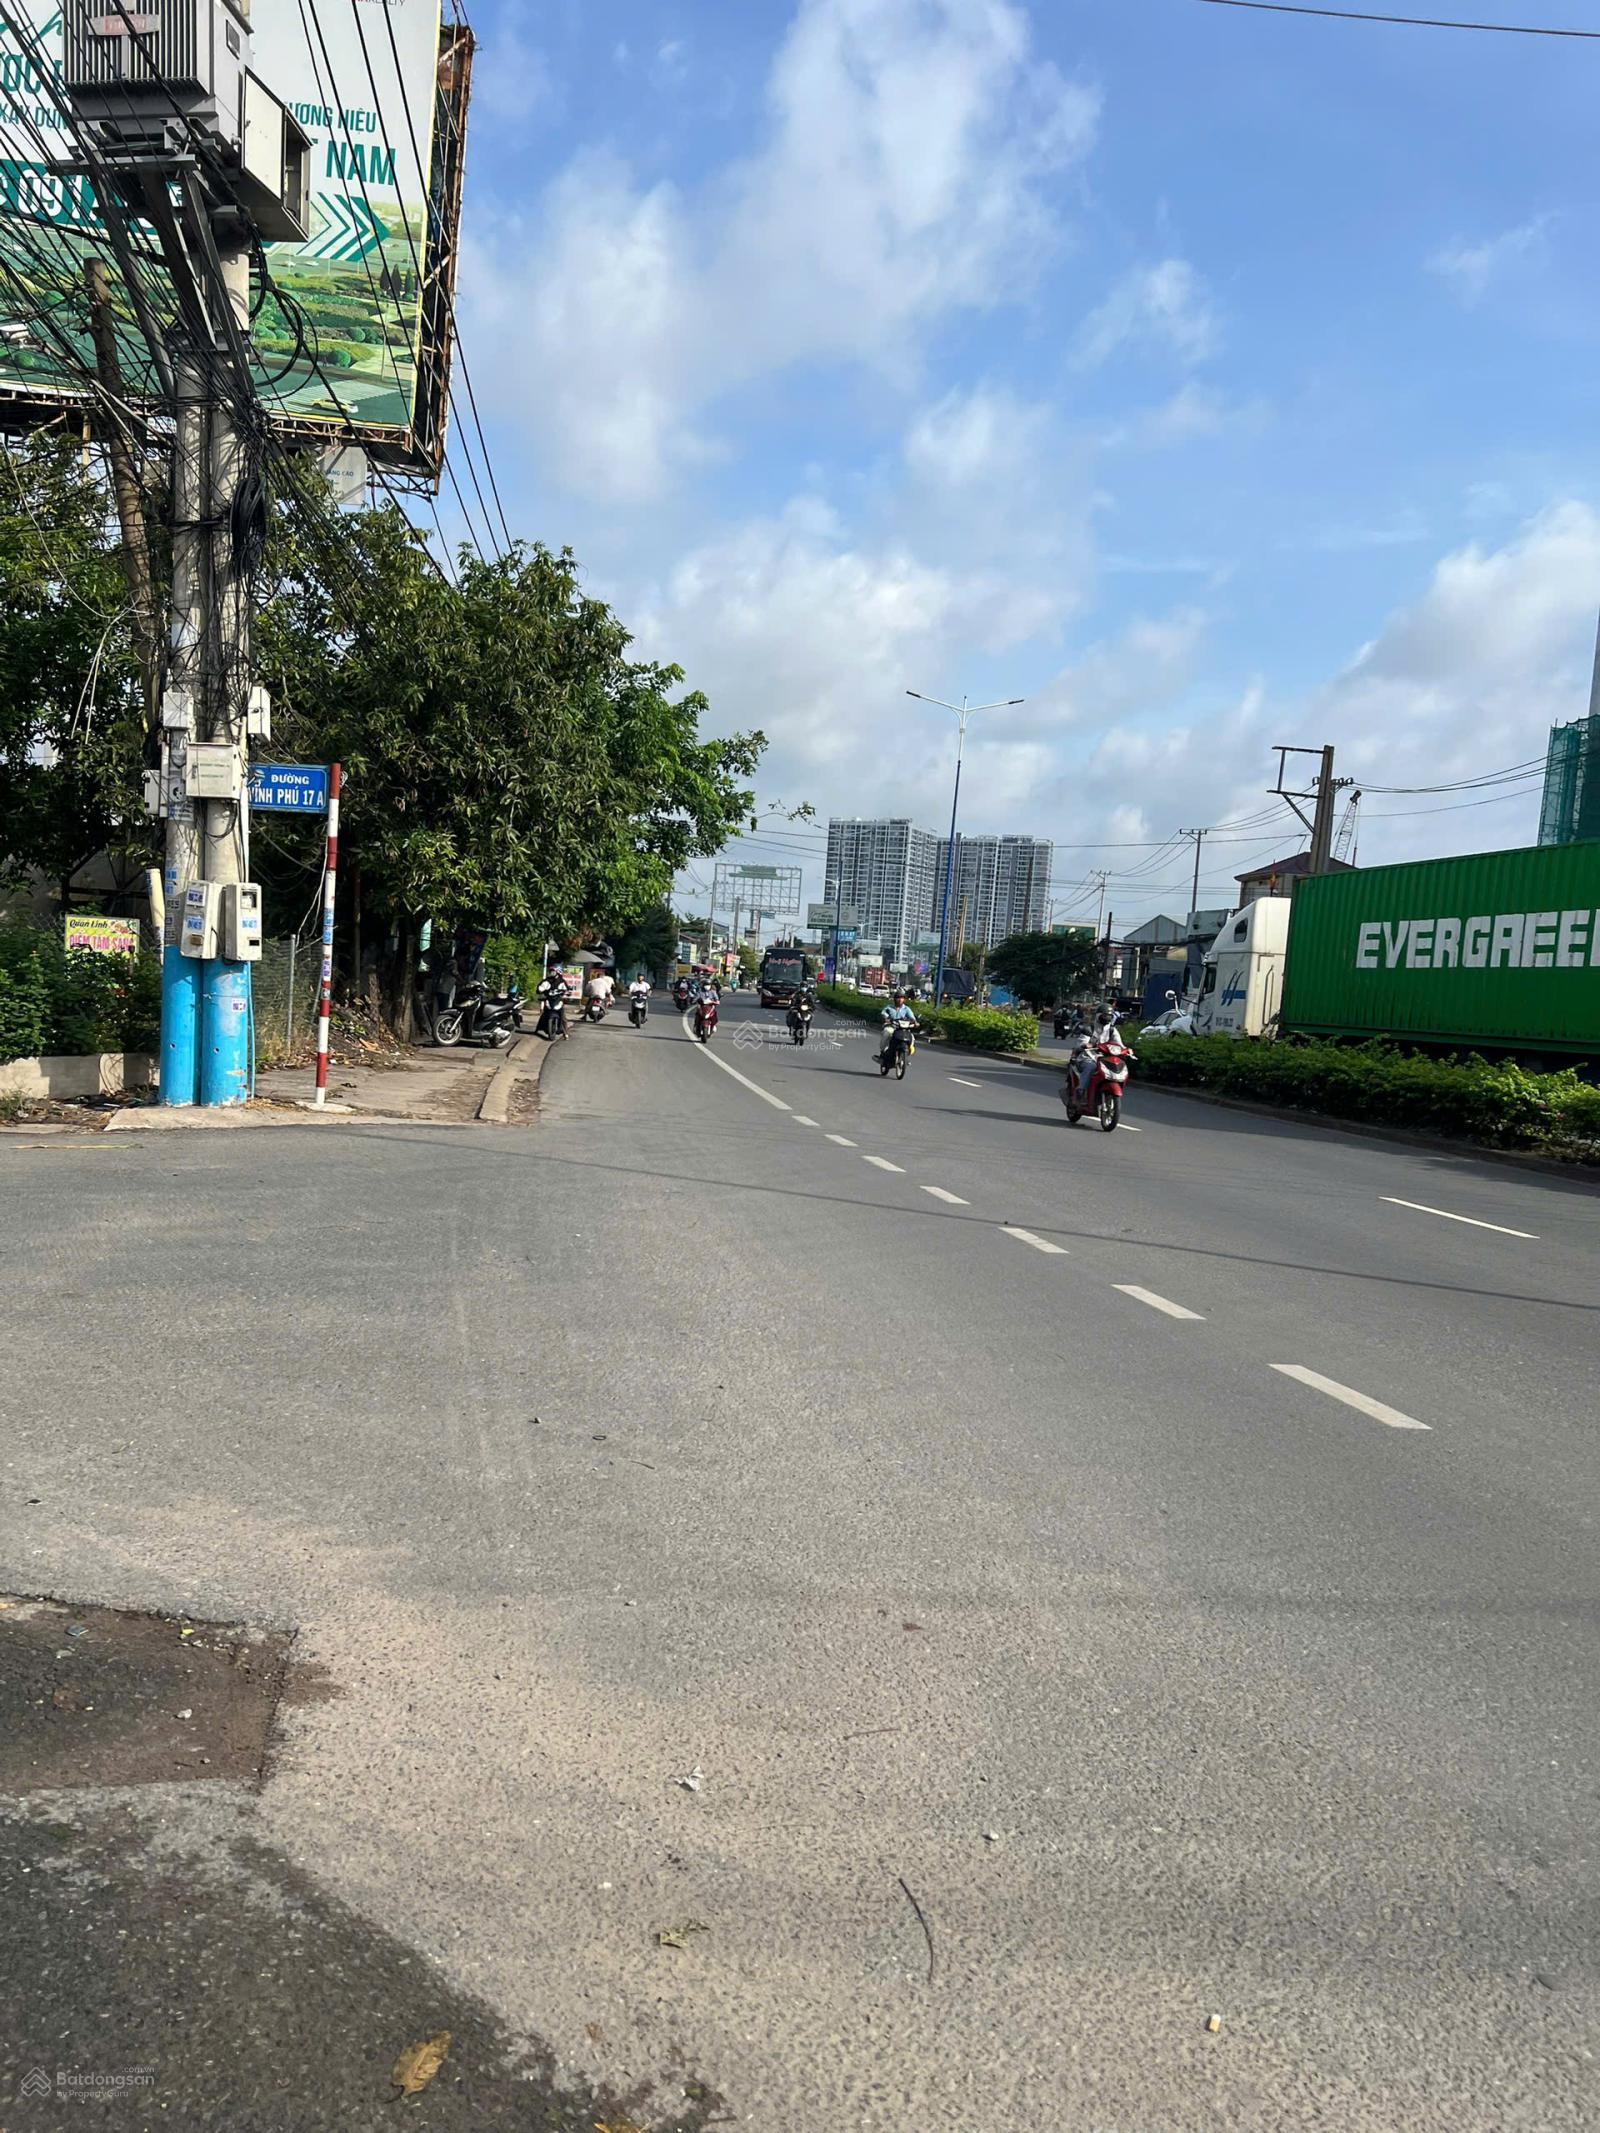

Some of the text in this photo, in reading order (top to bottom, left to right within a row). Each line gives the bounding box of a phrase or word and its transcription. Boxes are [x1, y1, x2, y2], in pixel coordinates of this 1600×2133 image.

[326, 140, 396, 186] NAM
[271, 772, 310, 785] ĐƯỜNG
[277, 785, 299, 805] PHÚ
[303, 789, 314, 806] 17
[316, 791, 324, 806] A
[1355, 908, 1600, 969] EVERGREE
